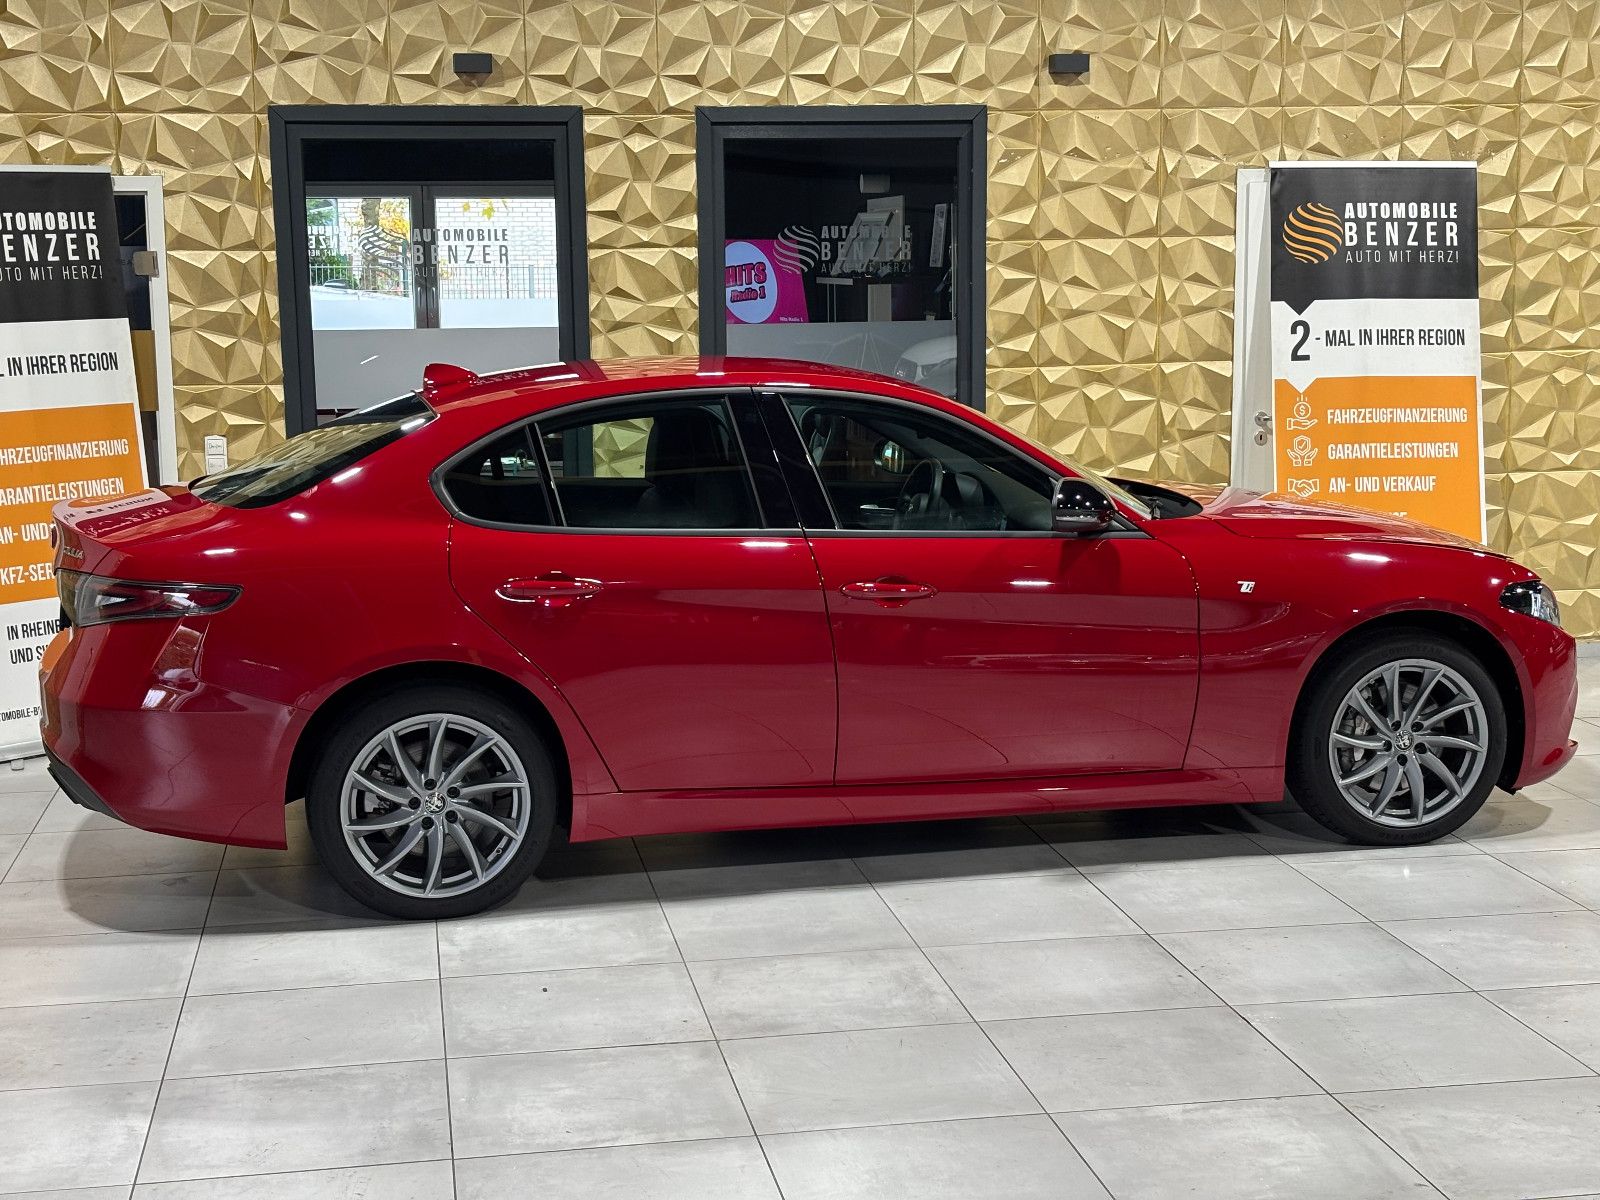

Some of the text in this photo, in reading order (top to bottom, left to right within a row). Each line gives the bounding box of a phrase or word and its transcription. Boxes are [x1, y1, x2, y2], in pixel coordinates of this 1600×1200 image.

[1344, 202, 1458, 219] AUTOMOBILE
[413, 228, 508, 242] AUTOMOBILE
[1344, 221, 1458, 247] BENZER
[2, 233, 100, 262] ENZER
[413, 244, 509, 265] BENZER
[1345, 249, 1460, 263] AUTO MIT HERZ!
[29, 266, 53, 281] MIT
[62, 264, 103, 280] HERZ!
[725, 262, 767, 287] HITS
[1290, 319, 1311, 361] 2
[1325, 330, 1356, 347] MAL
[1358, 329, 1373, 346] IN
[1376, 329, 1415, 346] IHRER
[1418, 328, 1466, 346] REGION
[7, 351, 119, 376] IN IHRER REGION
[1327, 407, 1468, 424] FAHRZEUGFINANZIERUNG
[1328, 442, 1459, 460] GARANTIELEISTUNGEN
[1328, 475, 1437, 493] AN- UND VERKAUF
[21, 522, 49, 542] UND
[6, 624, 20, 641] IN
[9, 647, 34, 665] UND
